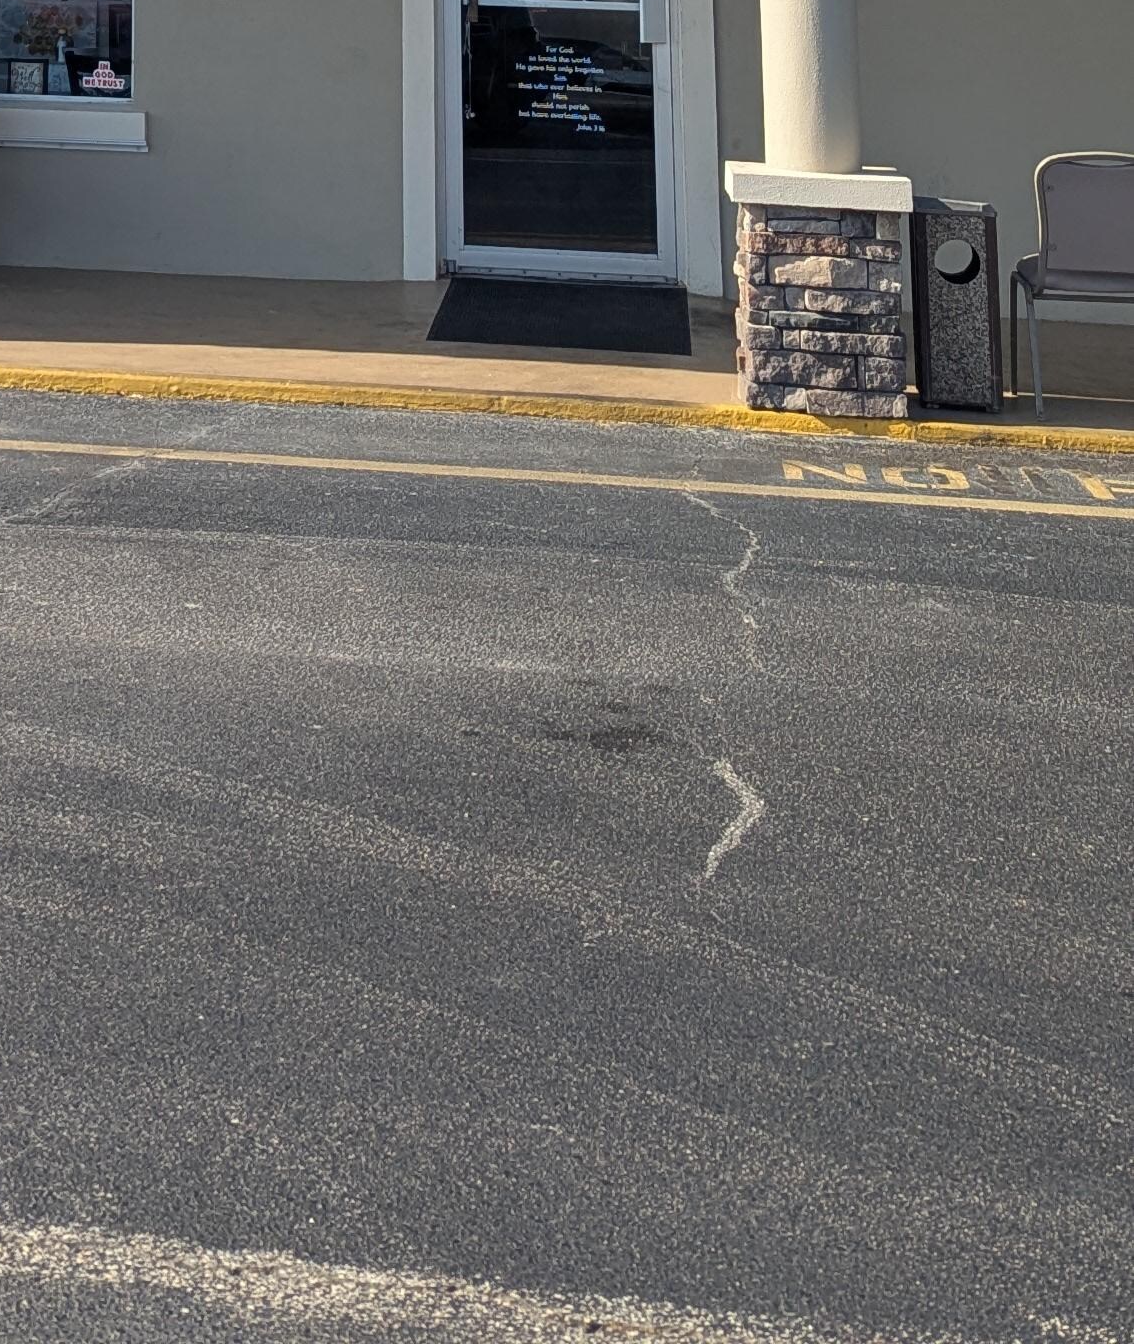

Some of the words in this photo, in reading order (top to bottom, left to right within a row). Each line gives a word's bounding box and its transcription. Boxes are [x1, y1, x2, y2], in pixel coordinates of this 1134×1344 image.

[100, 62, 109, 70] IN
[95, 71, 114, 79] GOD
[84, 79, 96, 87] WE
[97, 80, 124, 88] TRUST
[782, 461, 970, 490] NO
